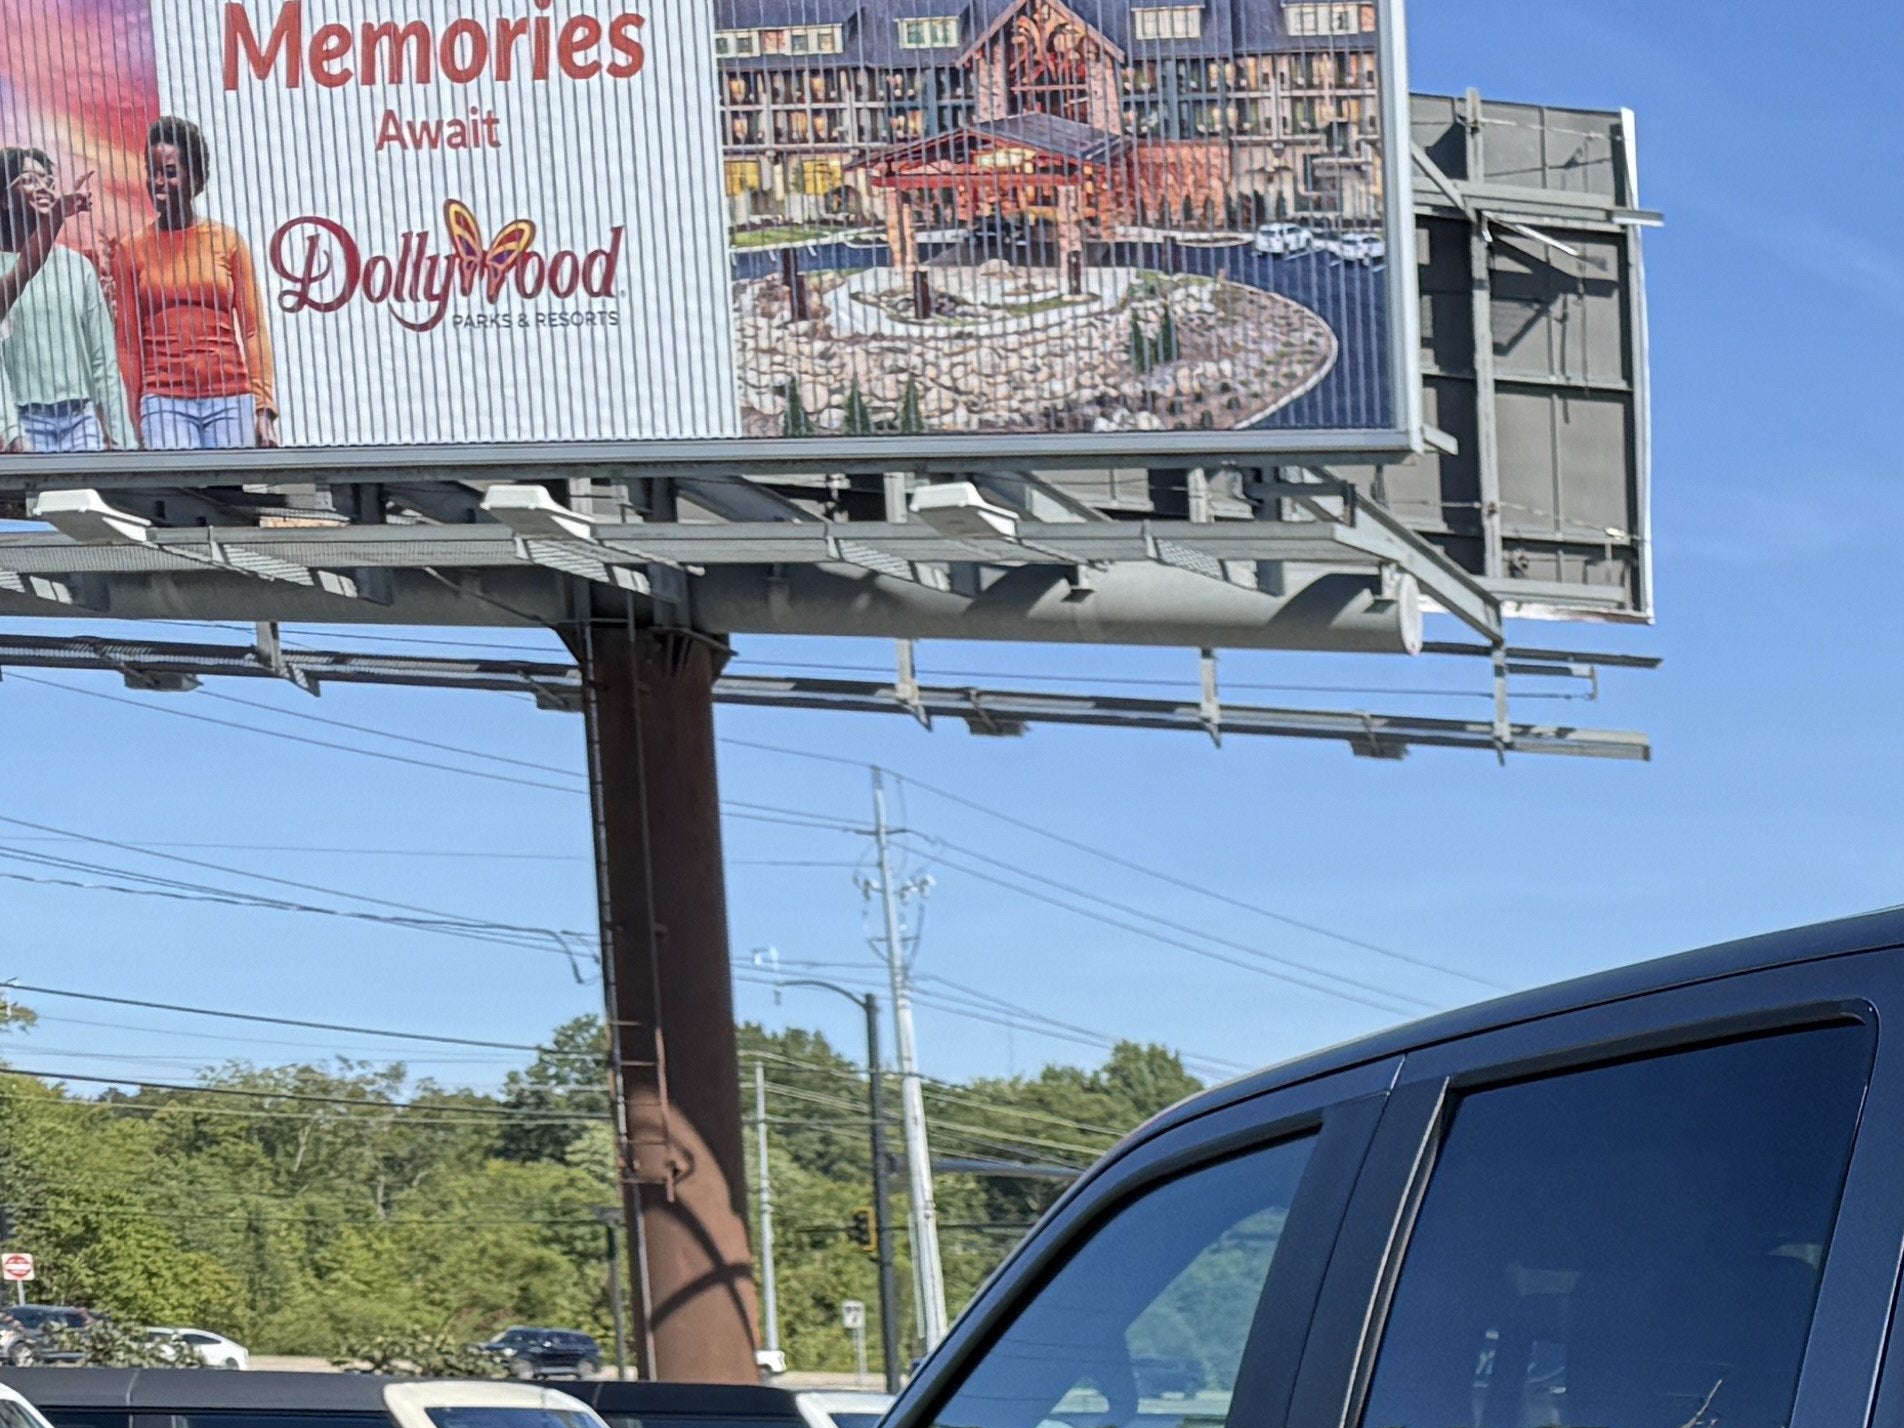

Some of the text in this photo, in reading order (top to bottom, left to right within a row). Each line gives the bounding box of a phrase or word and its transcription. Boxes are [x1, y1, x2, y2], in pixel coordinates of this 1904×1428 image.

[223, 0, 646, 91] Memories
[375, 106, 502, 151] Await
[452, 311, 620, 329] PARKS & RESORTS
